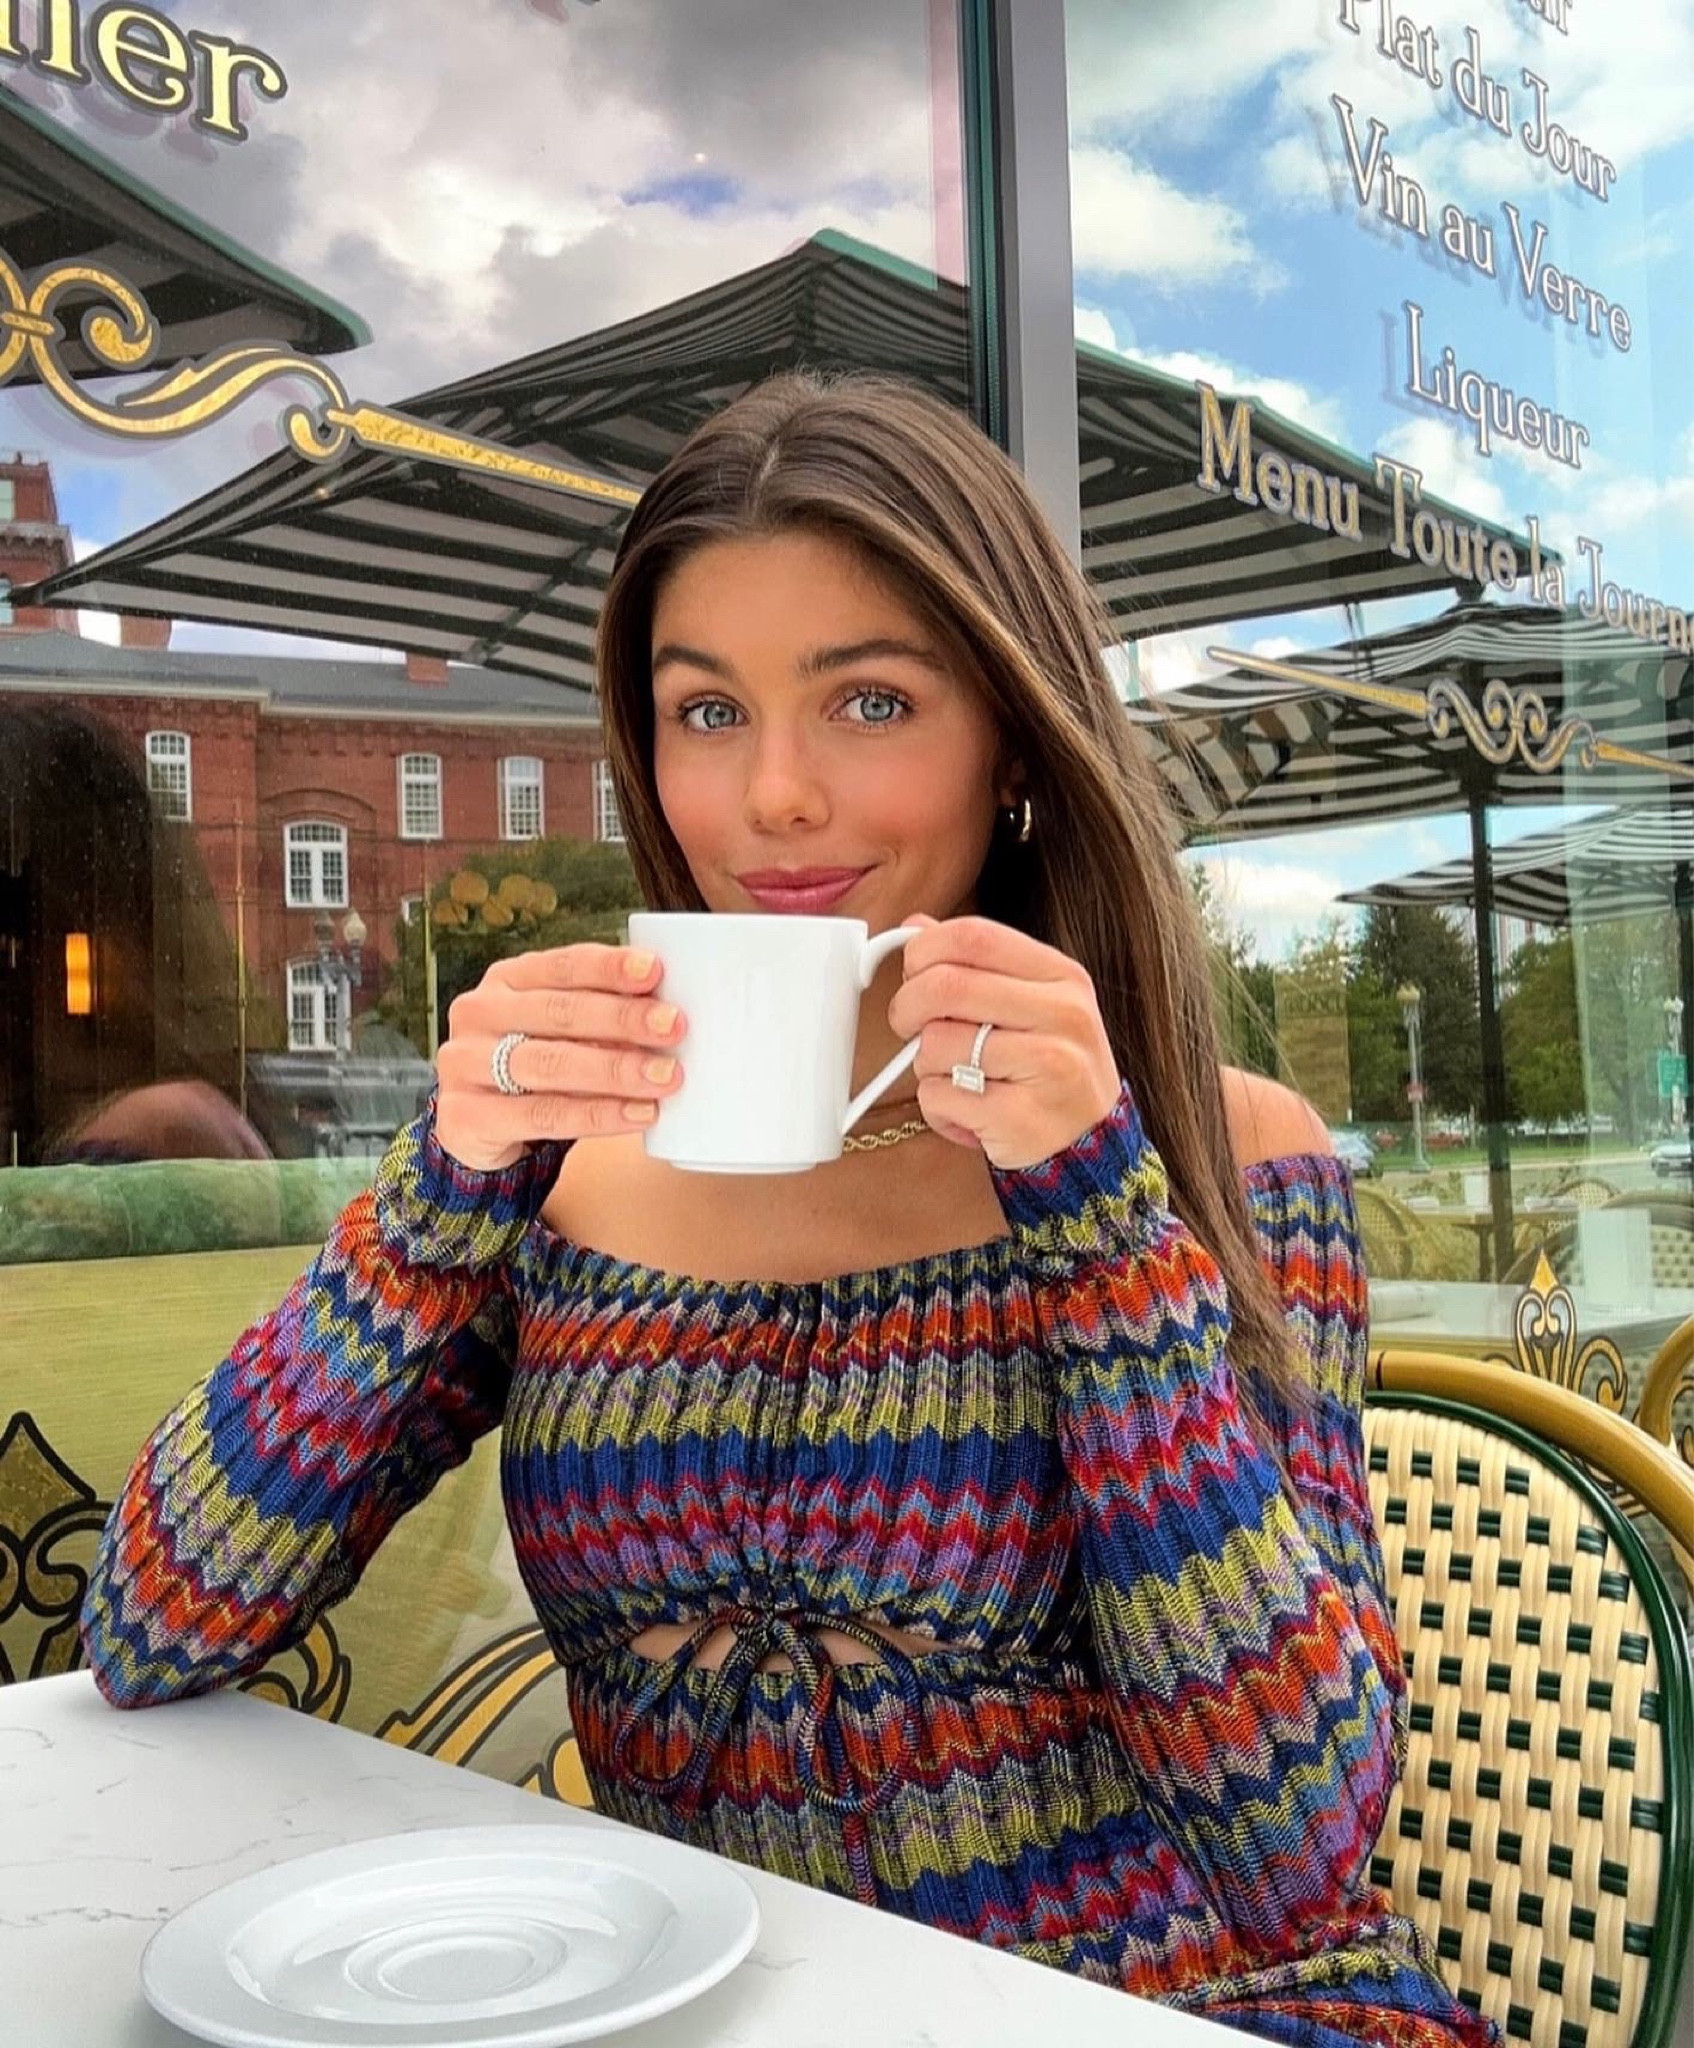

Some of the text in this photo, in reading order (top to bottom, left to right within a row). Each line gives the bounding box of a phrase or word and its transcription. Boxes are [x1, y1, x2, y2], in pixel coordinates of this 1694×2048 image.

[1331, 92, 1632, 351] Vin au Verre
[1450, 26, 1512, 137] du
[1522, 67, 1617, 202] Jour
[1404, 300, 1591, 470] Liqueur
[1195, 379, 1694, 658] Menu Toute la Journ
